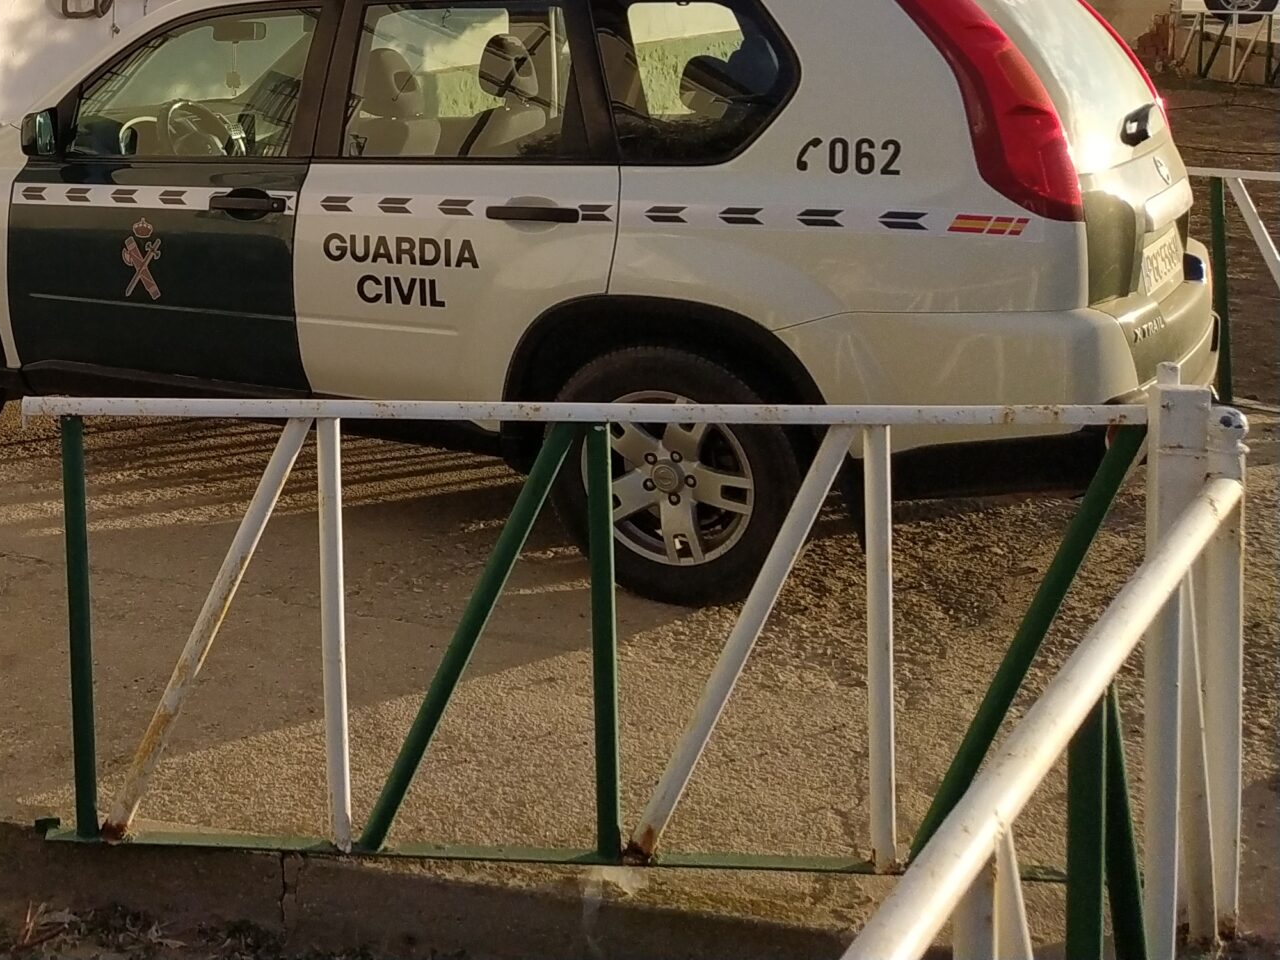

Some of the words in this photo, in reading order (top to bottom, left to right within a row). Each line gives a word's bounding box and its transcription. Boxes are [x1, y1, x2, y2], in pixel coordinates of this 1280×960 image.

[828, 137, 901, 175] 062
[323, 232, 479, 269] GUARDIA
[356, 274, 446, 307] CIVIL
